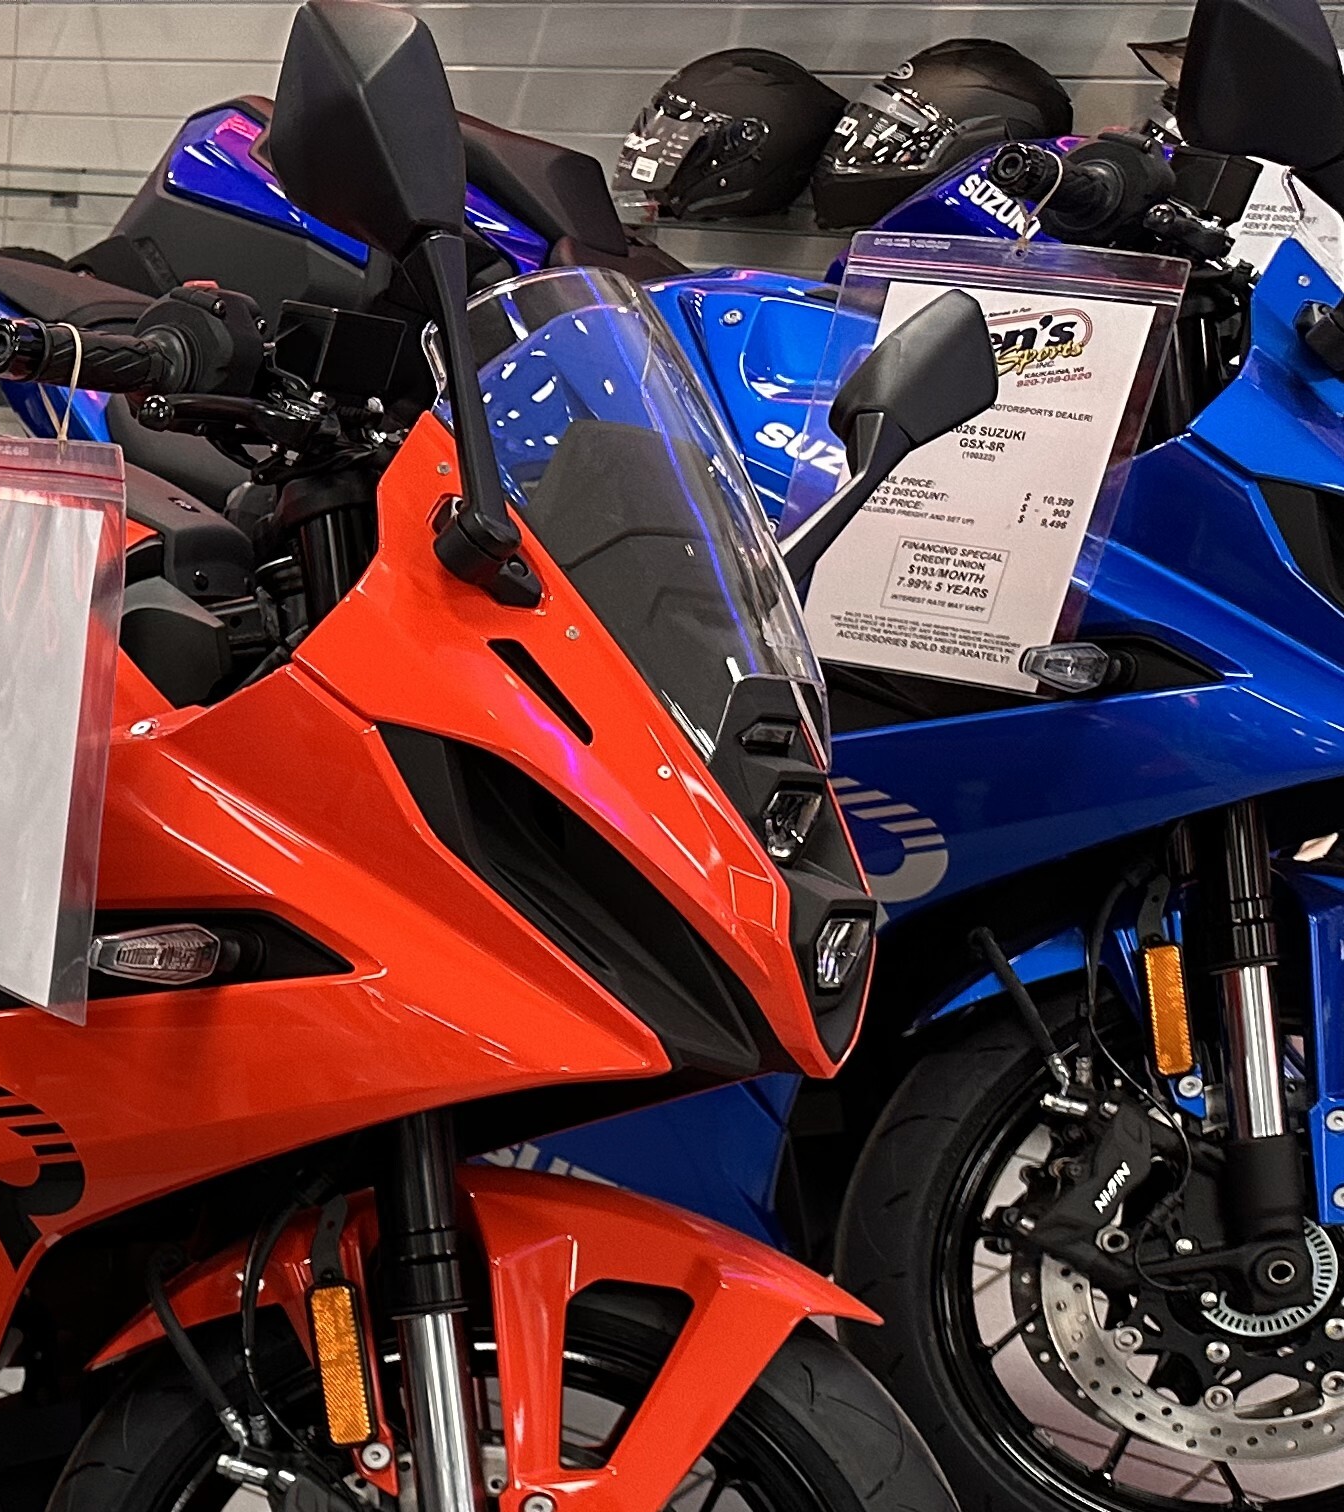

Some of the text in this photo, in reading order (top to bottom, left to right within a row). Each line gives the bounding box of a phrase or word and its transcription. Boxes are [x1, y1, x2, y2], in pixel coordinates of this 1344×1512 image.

[958, 173, 1041, 240] SUZUKI
[989, 315, 1078, 354] en's
[996, 340, 1085, 377] Sports
[978, 426, 1026, 441] SUZUKI
[755, 422, 847, 475] SUZ
[959, 438, 1005, 453] GSX-8R
[900, 476, 937, 489] PRICE:
[892, 486, 950, 502] DISCOUNT:
[1024, 492, 1032, 502] $
[861, 505, 896, 514] CLUDING
[889, 497, 925, 510] PRICE:
[1020, 503, 1028, 513] $
[1017, 514, 1025, 524] $
[901, 540, 1003, 563] FINANCING SPECIAL
[913, 552, 987, 571] CREDIT UNION
[934, 582, 943, 592] 5
[946, 583, 989, 599] YEARS
[836, 629, 908, 648] ACCESSORIES
[909, 640, 938, 652] SOLD
